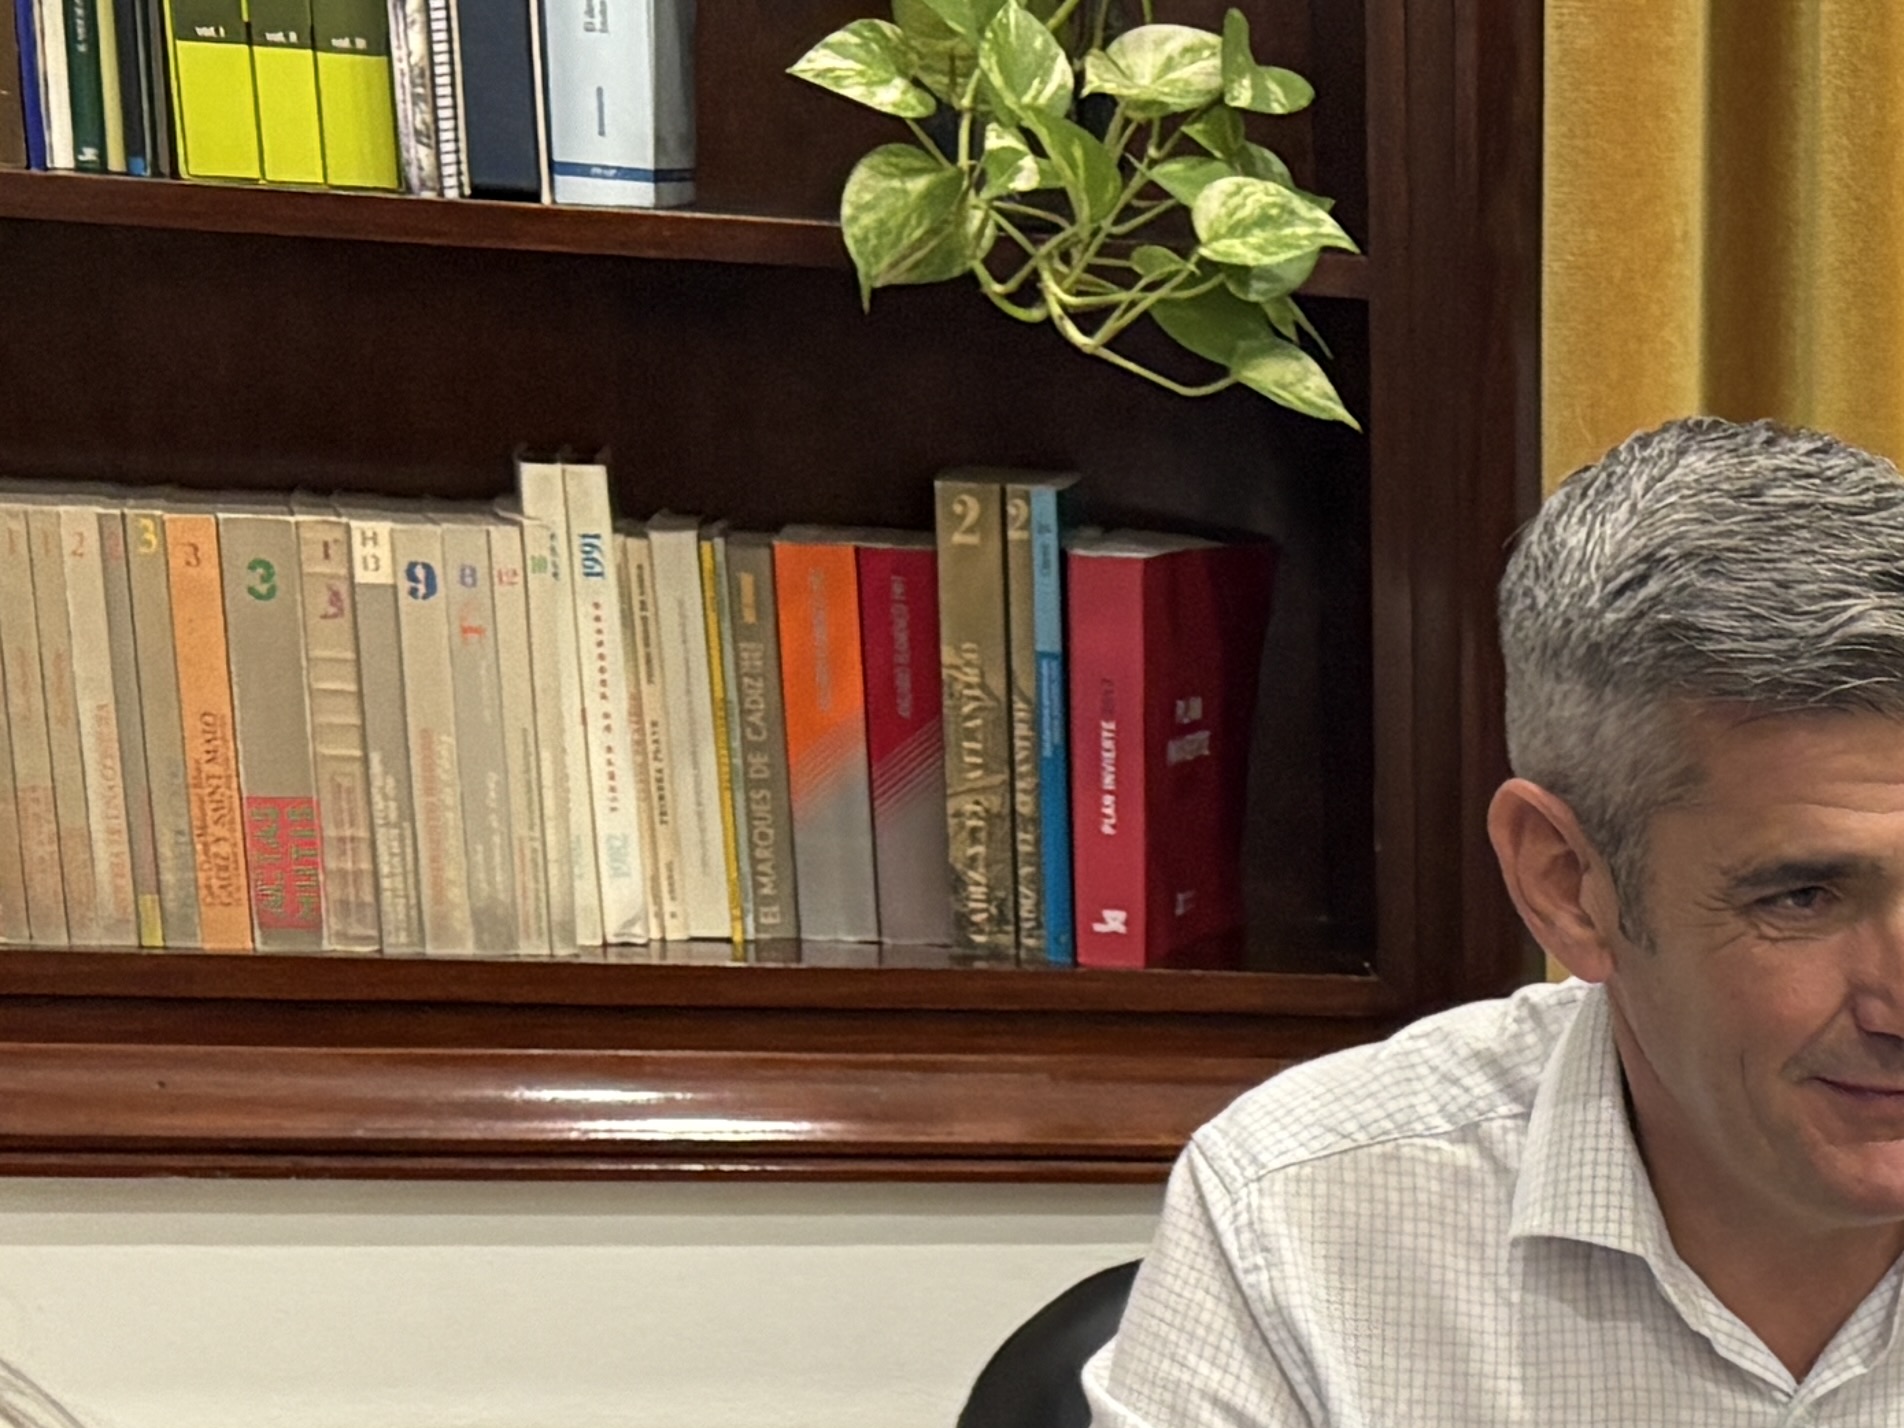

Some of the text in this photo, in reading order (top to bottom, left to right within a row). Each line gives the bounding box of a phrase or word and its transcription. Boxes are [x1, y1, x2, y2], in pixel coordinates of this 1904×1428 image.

[137, 516, 158, 555] 3
[360, 528, 379, 548] H
[950, 494, 981, 545] 2
[1006, 498, 1029, 542] 2
[178, 541, 202, 568] 3
[579, 532, 606, 580] 1991
[246, 557, 279, 602] 3
[404, 560, 439, 602] 9
[742, 677, 769, 743] CADIZ
[746, 752, 770, 778] DE
[1099, 720, 1117, 790] INVIERTE
[1100, 795, 1117, 835] PLAN
[750, 788, 777, 898] MARQUES
[759, 903, 781, 926] EL
